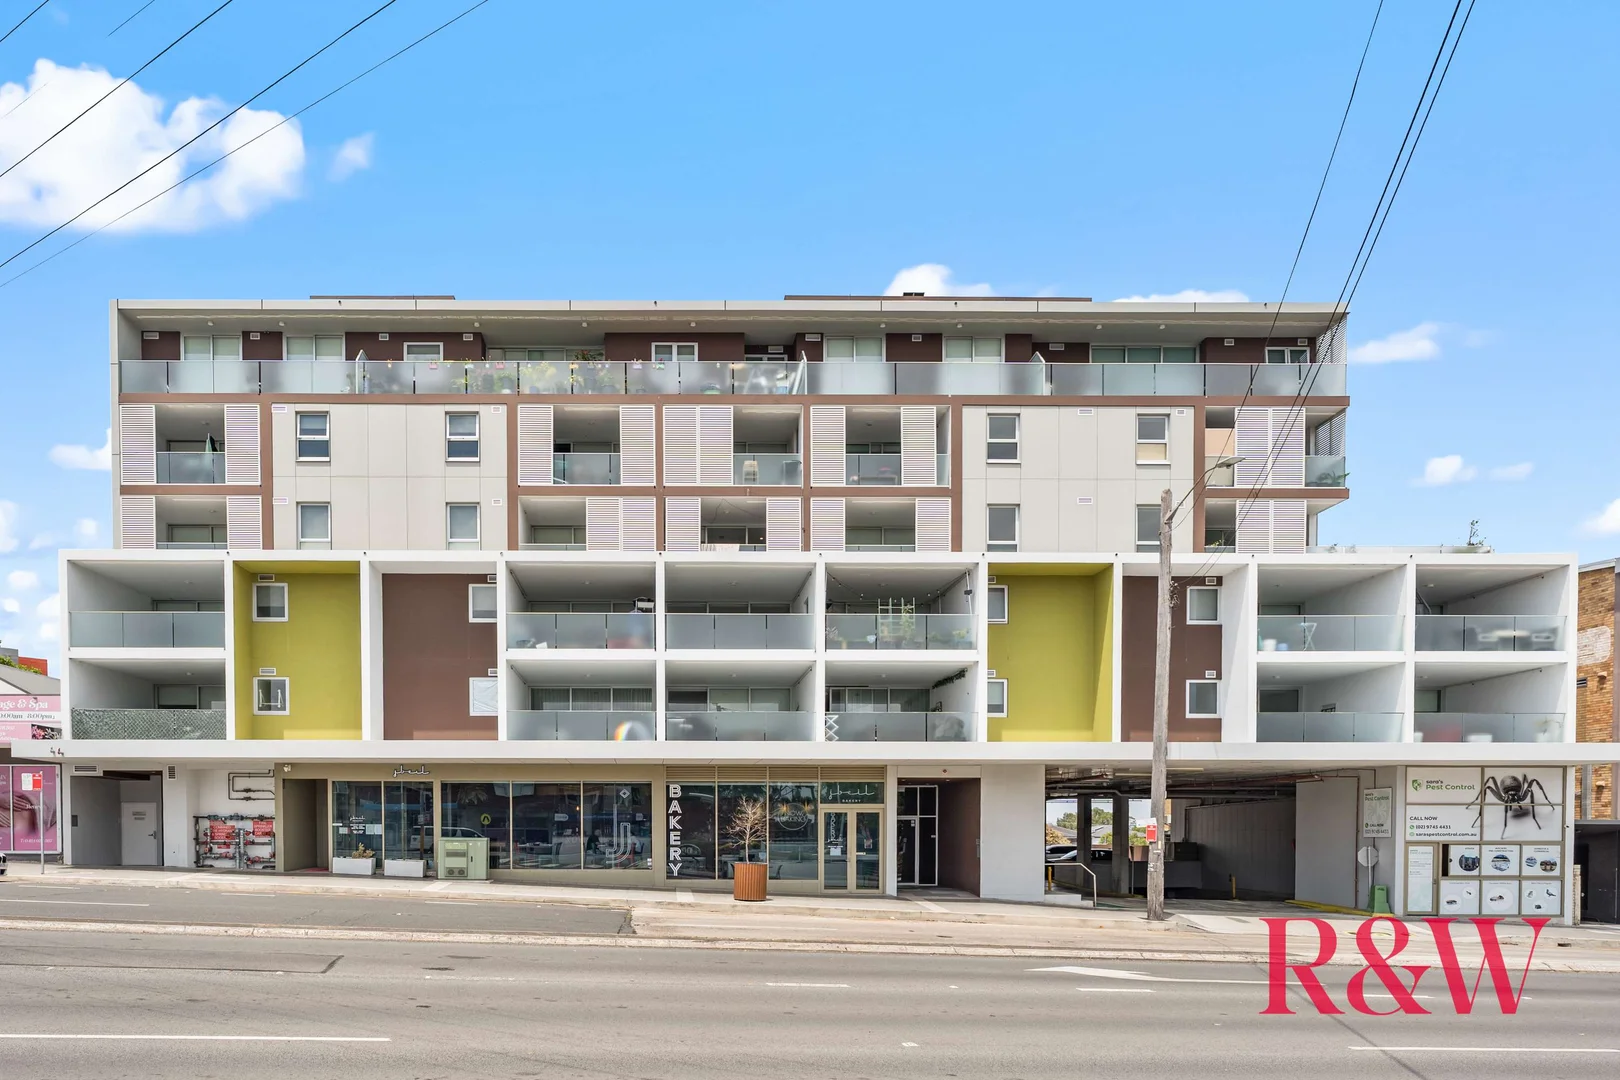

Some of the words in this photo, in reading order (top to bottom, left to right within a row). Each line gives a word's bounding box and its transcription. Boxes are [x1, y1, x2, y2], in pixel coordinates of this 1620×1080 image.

[17, 699, 26, 708] &
[28, 698, 48, 710] Spa
[667, 784, 683, 877] BAKERY
